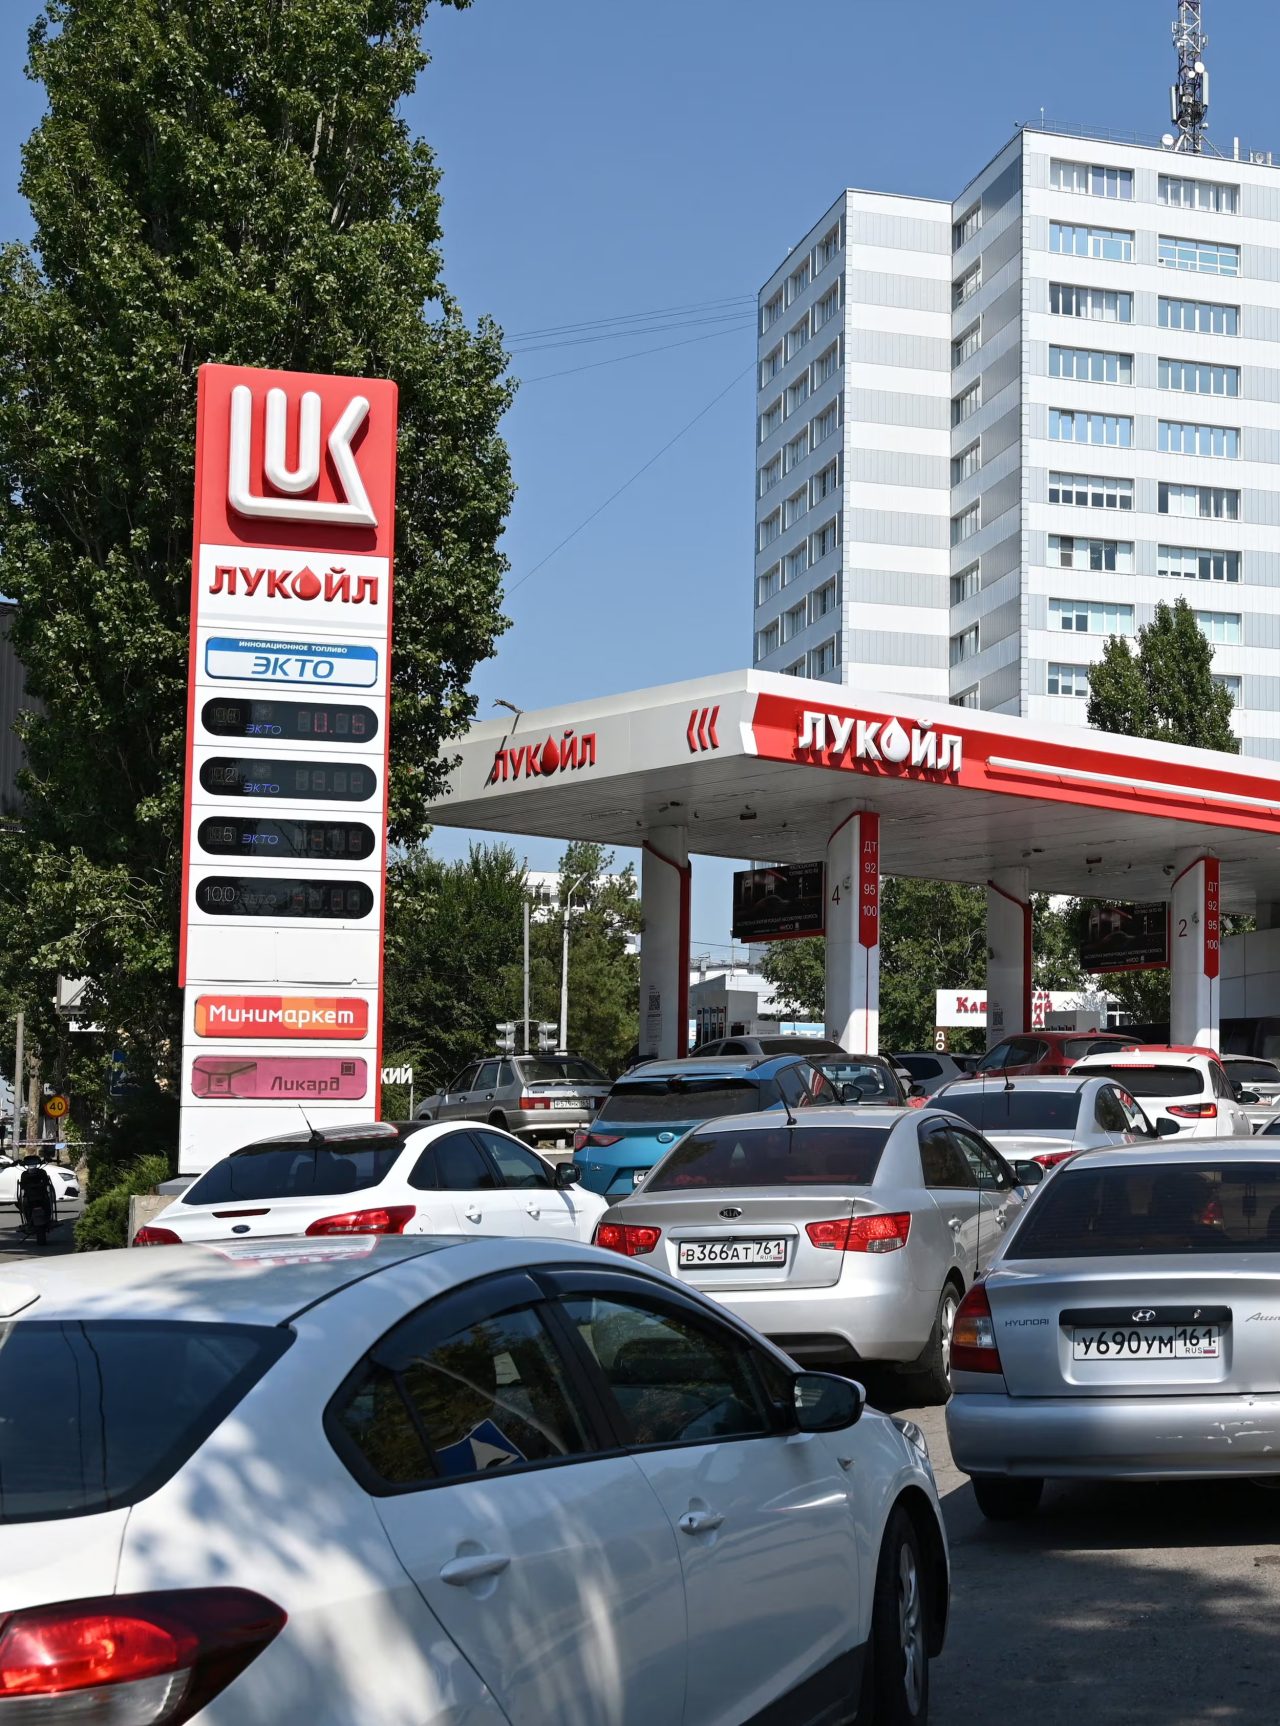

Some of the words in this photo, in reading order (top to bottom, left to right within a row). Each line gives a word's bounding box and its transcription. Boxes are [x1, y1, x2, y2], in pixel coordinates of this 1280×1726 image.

[209, 565, 378, 605] ЛУКОЙЛ
[239, 641, 308, 651] ИННОВАЦИОННОЕ
[311, 645, 348, 654] ТОПЛИВО
[251, 656, 335, 679] ЭКТО
[245, 723, 282, 735] ЭКТО
[798, 710, 963, 772] ЛУКОЙЛ
[490, 729, 596, 786] ЛУКОЙЛ
[243, 783, 280, 794] ЭКТО
[241, 833, 279, 845] ЭКТО
[863, 841, 877, 853] ДТ
[864, 863, 877, 874] 92
[204, 886, 236, 902] 100
[832, 884, 841, 905] 4
[864, 884, 876, 895] 95
[862, 905, 877, 917] 100
[1208, 900, 1217, 911] 92
[1178, 919, 1188, 938] 2
[1208, 920, 1218, 930] 95
[1207, 939, 1218, 950] 100
[209, 1004, 354, 1028] Минимаркет
[270, 1076, 340, 1095] Ликард
[49, 1102, 64, 1111] 40
[723, 1209, 738, 1218] KIA
[686, 1243, 752, 1262] В366АТ
[755, 1241, 782, 1255] 761
[1005, 1318, 1050, 1327] HYUNDAI
[1081, 1331, 1173, 1355] У690УМ
[1178, 1328, 1213, 1347] 161
